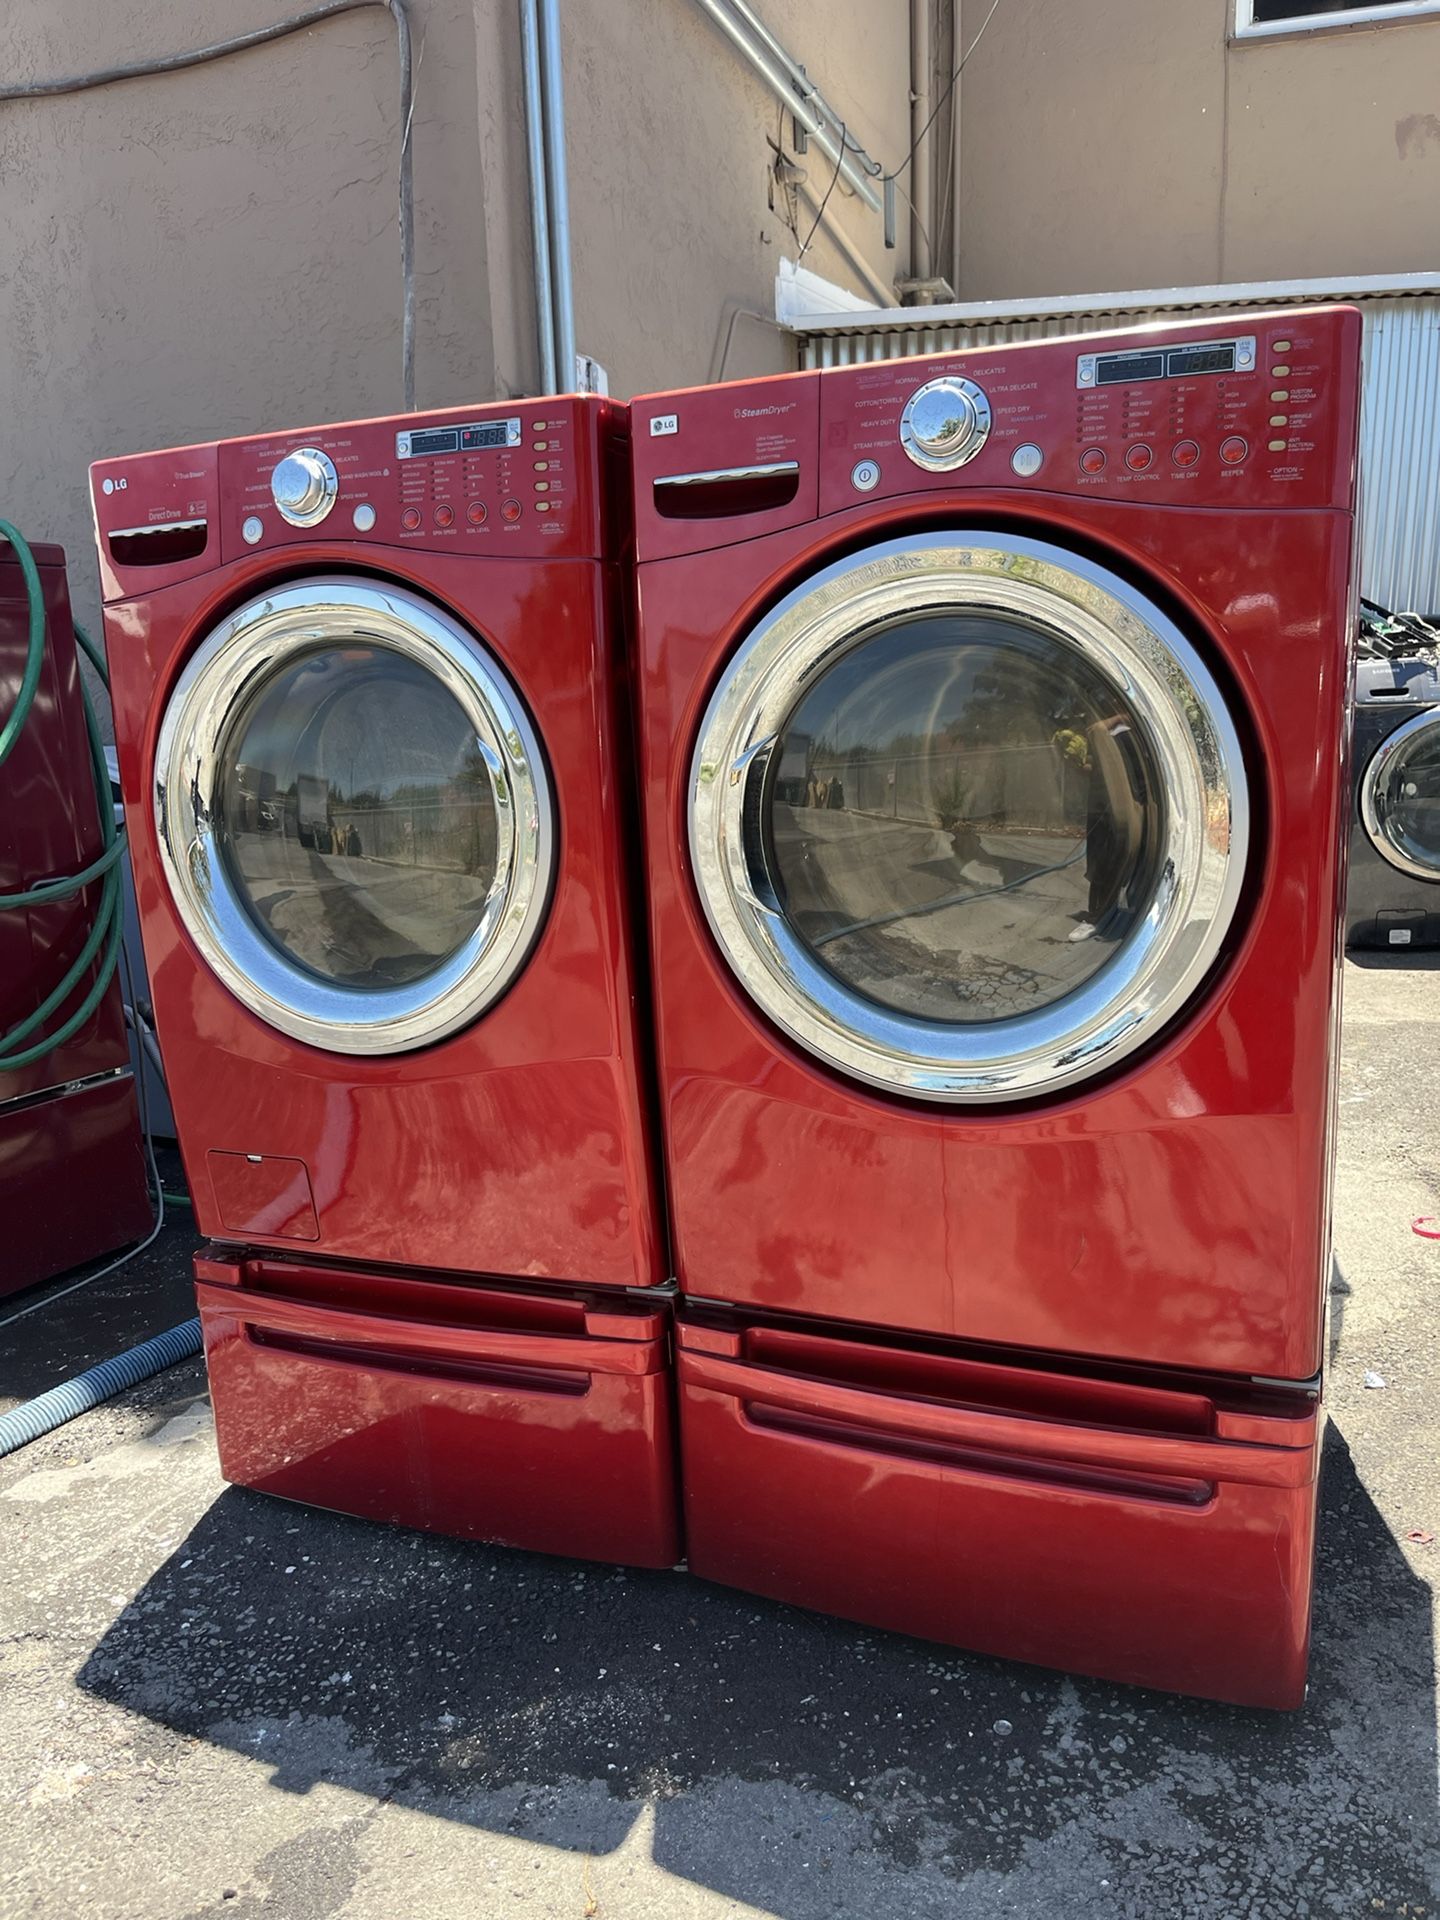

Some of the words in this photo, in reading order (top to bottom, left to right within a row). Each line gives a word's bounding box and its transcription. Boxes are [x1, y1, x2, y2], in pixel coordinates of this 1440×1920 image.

[947, 362, 966, 370] PRESS
[973, 367, 1006, 376] DELICATES
[895, 376, 920, 385] NORMAL
[989, 385, 1008, 393] ULTRA
[1010, 382, 1038, 392] DELICATE
[1290, 392, 1316, 400] PROGRAM
[855, 396, 903, 408] COTTON/TOWELS
[997, 407, 1017, 415] SPEED
[664, 420, 674, 429] LG
[860, 420, 879, 428] HEAVY
[880, 418, 896, 426] DUTY
[1006, 428, 1018, 436] DRY
[854, 442, 872, 450] STEAM
[1221, 469, 1244, 478] BEEPER
[1274, 466, 1298, 474] OPTION
[1090, 476, 1108, 484] LEVEL
[1133, 473, 1160, 481] CONTROL
[115, 478, 128, 491] LG
[149, 511, 166, 521] Direct
[166, 510, 181, 519] Drive
